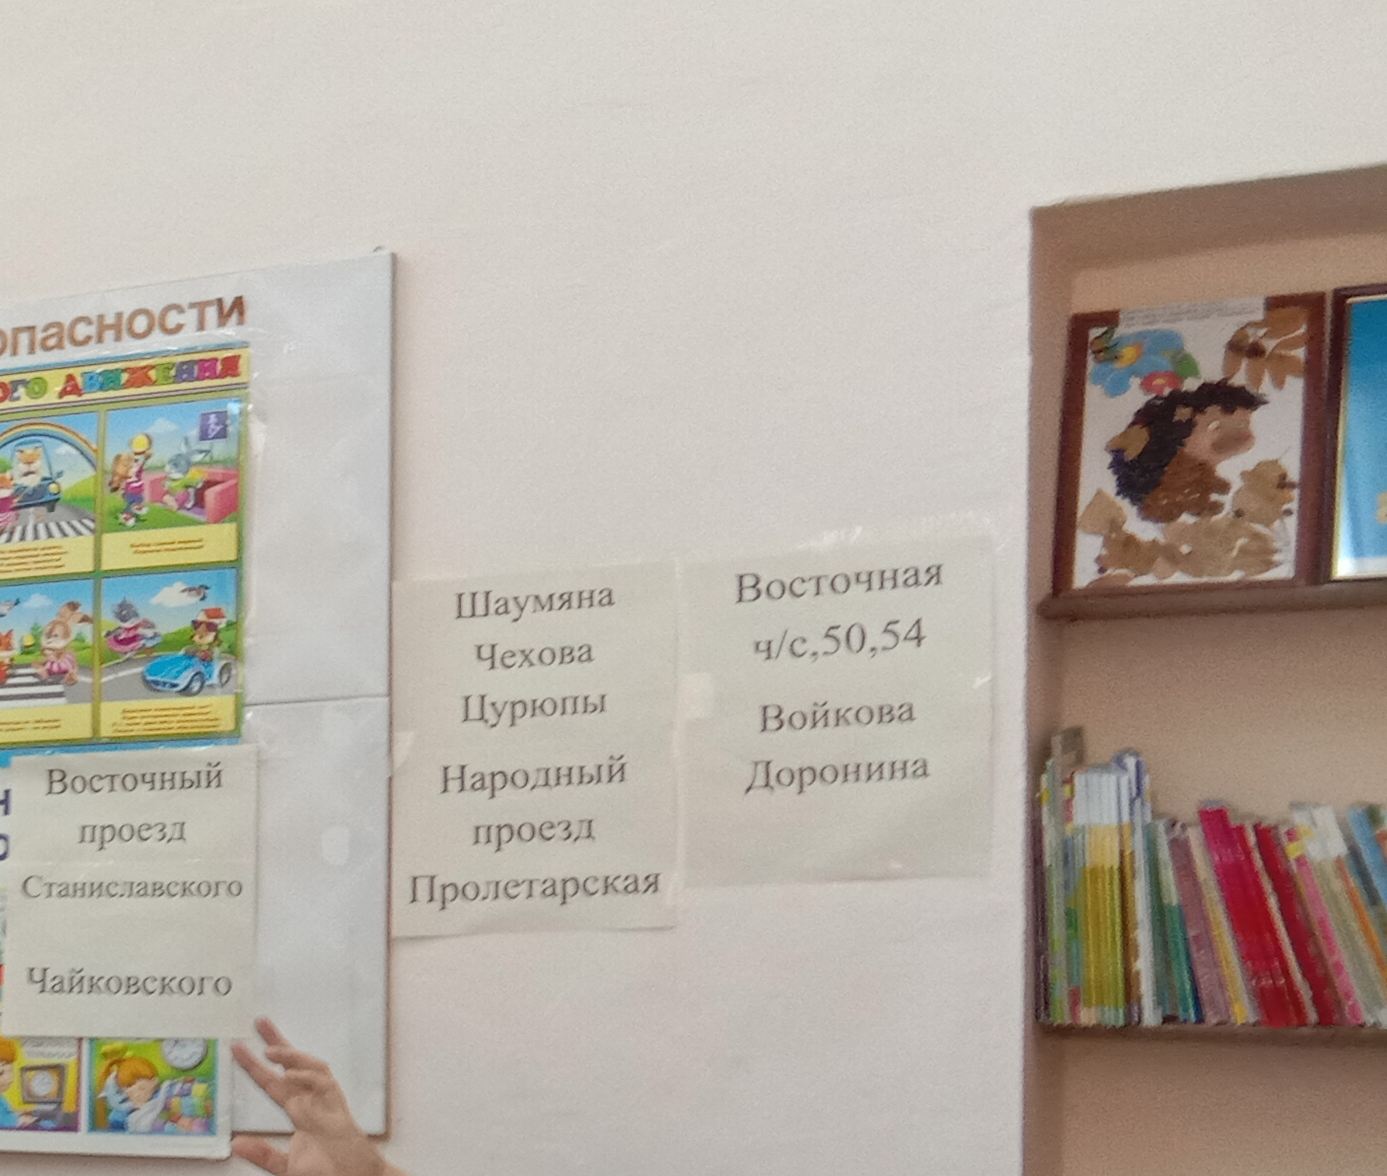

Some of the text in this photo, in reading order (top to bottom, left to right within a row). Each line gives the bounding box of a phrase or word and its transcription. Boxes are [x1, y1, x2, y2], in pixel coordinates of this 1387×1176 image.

[59, 355, 241, 398] ДВИЖЕНИЯ
[735, 564, 944, 604] Восточная
[455, 585, 615, 621] Шаумяна
[473, 640, 594, 671] Чехова
[753, 617, 927, 663] ч/с,50,54
[460, 691, 607, 728] Цурюпы
[759, 700, 916, 733] Войкова
[46, 762, 223, 796] Восточный
[440, 754, 627, 799] Народный
[745, 756, 930, 795] Доронина
[78, 820, 186, 850] проезд
[472, 816, 595, 852] проезд
[22, 873, 243, 900] Станиславского
[408, 870, 661, 910] Пролетарская
[28, 966, 232, 996] Чайковского
